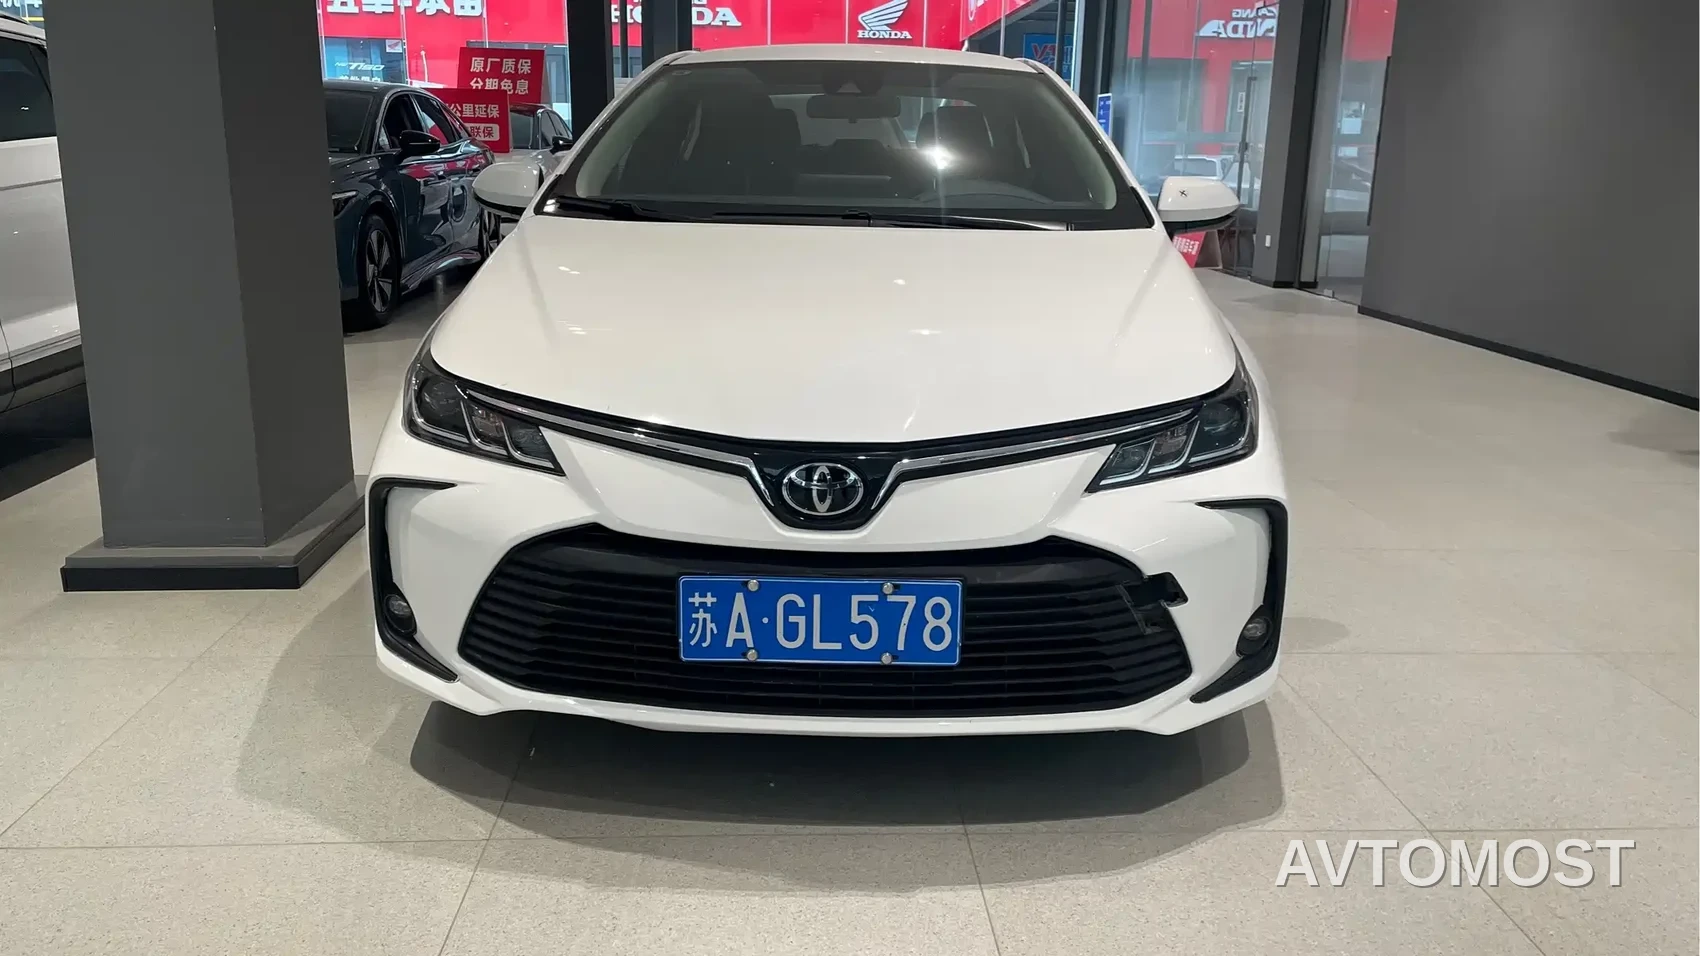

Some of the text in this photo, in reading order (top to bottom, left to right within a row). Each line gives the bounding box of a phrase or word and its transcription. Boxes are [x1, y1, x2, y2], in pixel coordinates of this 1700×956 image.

[857, 30, 912, 39] HONDA
[470, 57, 531, 74] 原厂质保
[470, 77, 529, 95] 分期免息
